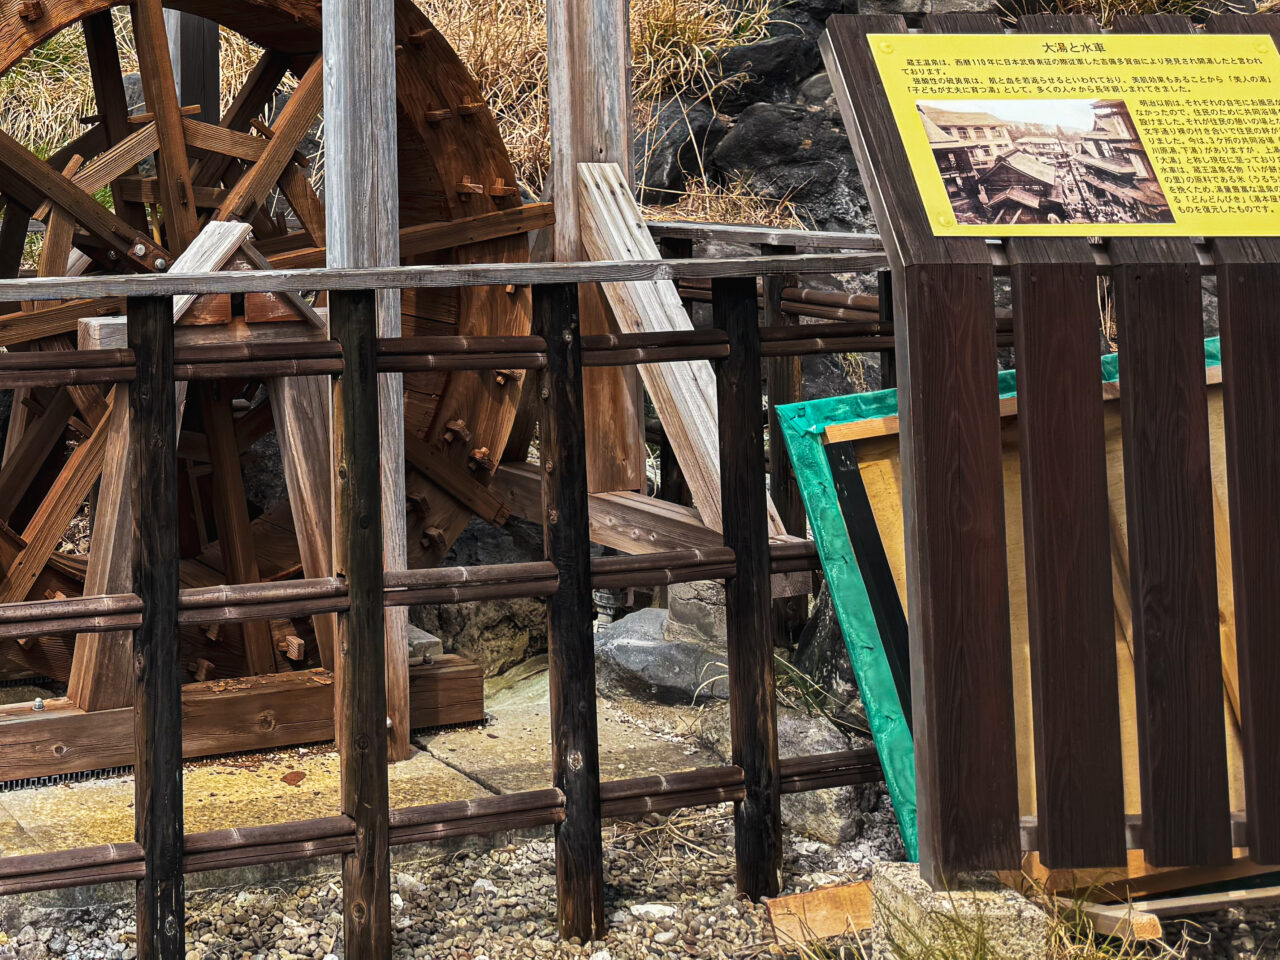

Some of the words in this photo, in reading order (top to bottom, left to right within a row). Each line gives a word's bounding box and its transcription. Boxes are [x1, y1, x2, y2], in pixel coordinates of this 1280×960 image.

[1042, 42, 1107, 53] 大湯と水車
[901, 68, 947, 76] ております。
